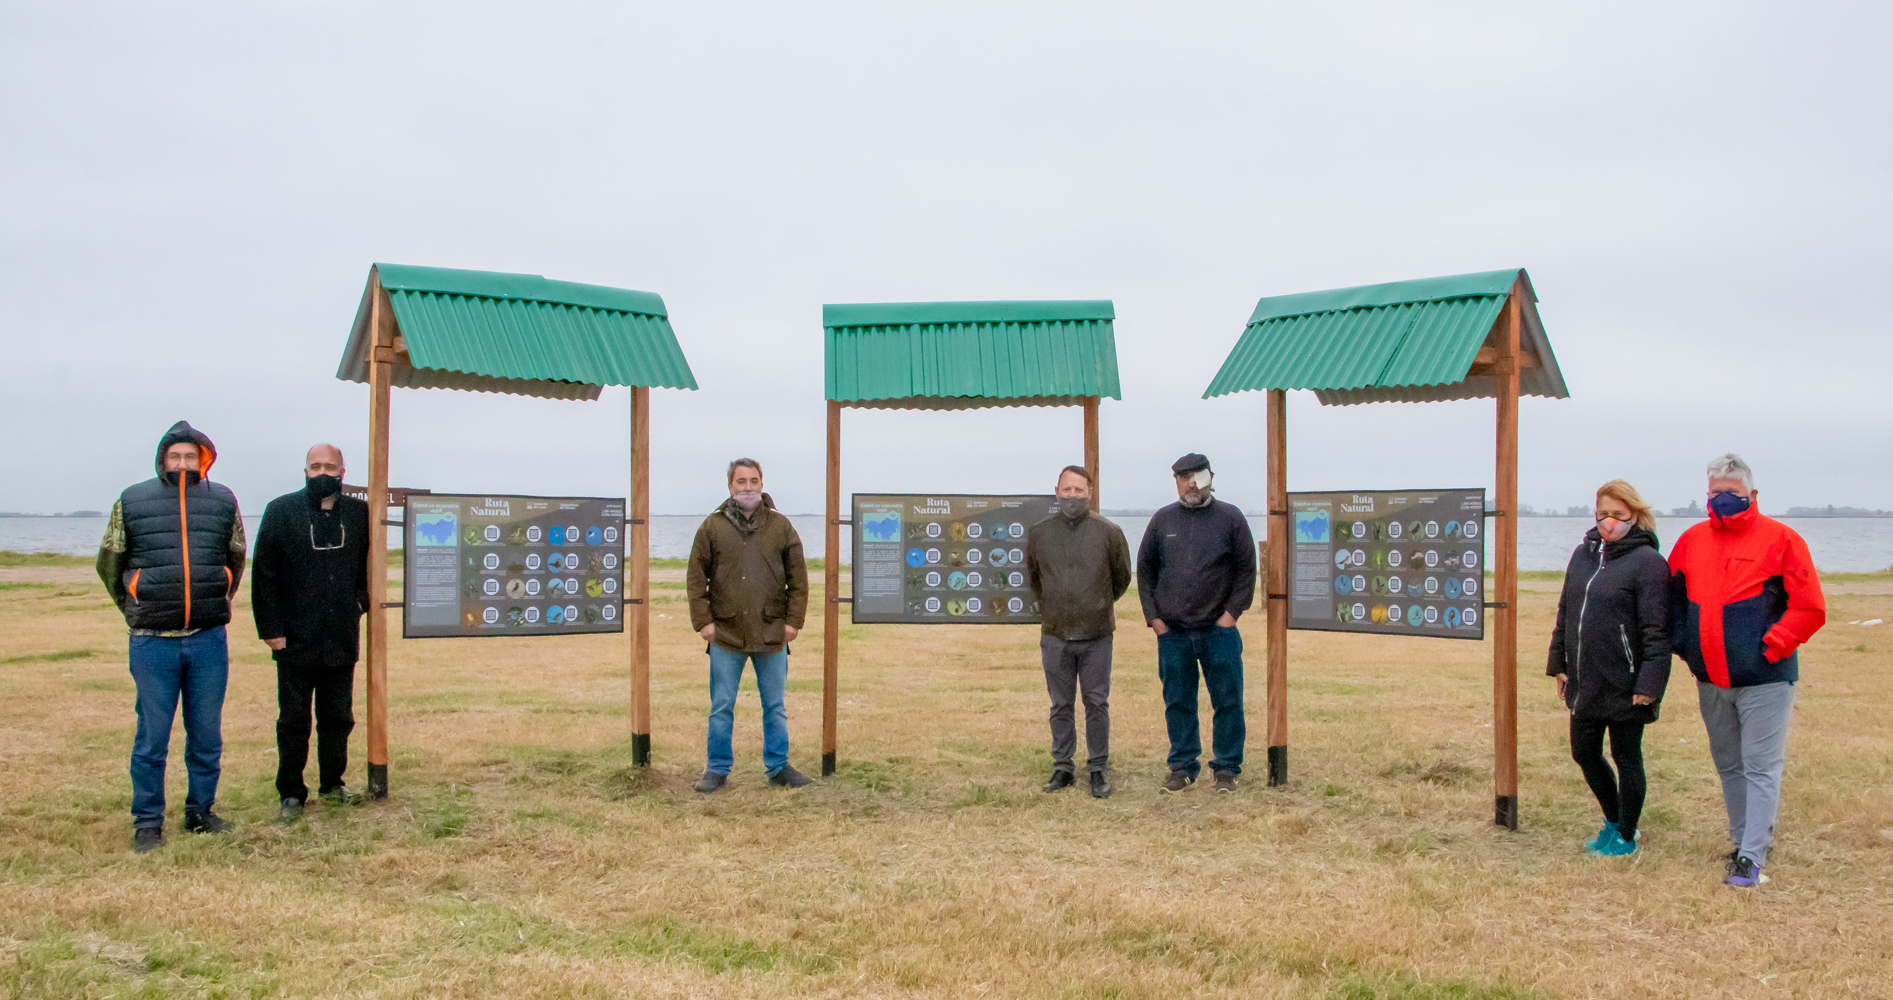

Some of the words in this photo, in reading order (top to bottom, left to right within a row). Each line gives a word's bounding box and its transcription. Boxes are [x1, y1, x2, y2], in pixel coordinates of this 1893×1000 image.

[485, 498, 510, 507] Ruta
[926, 497, 950, 507] Ruta
[1352, 494, 1373, 504] Ruta
[470, 506, 510, 516] Natural
[913, 505, 950, 514] Natural
[1340, 503, 1374, 512] Natural
